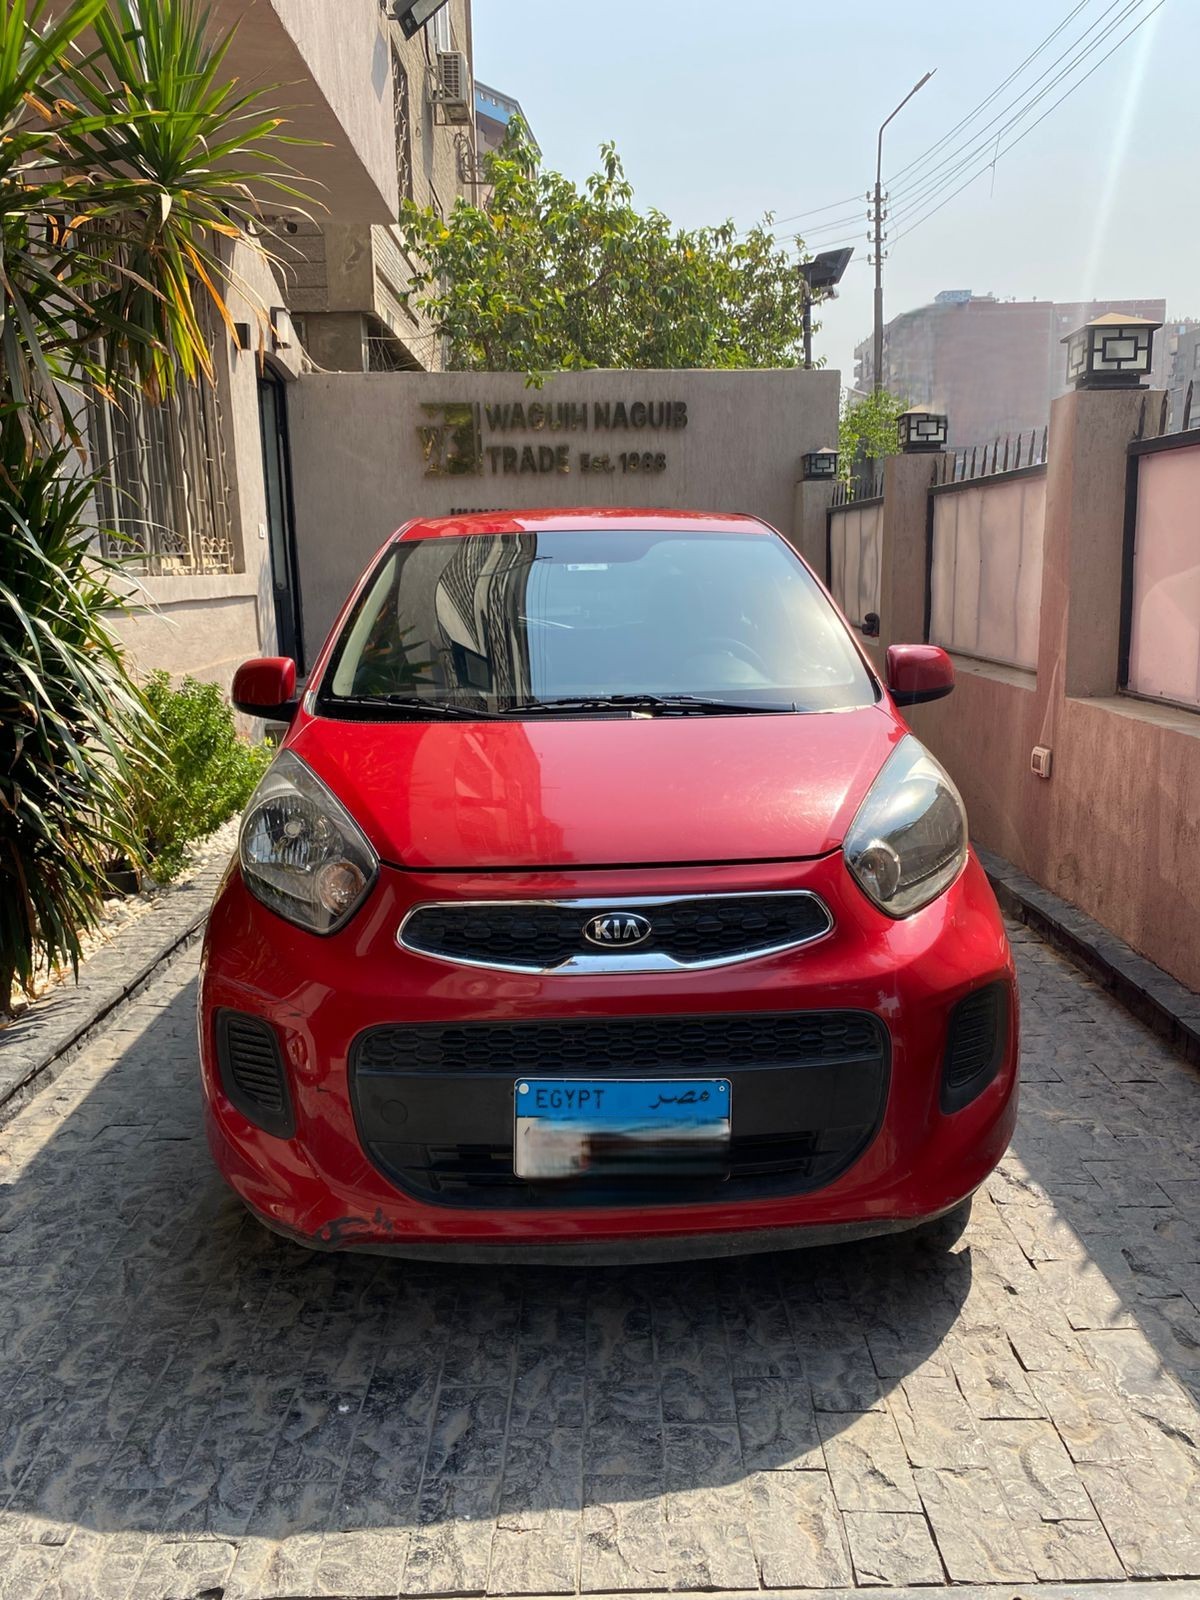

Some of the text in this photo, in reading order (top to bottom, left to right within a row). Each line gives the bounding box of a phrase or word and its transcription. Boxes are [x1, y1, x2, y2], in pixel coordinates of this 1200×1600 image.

[484, 402, 688, 432] WAGUIH NAGUIB
[485, 446, 570, 474] TRADE
[594, 919, 641, 939] KIA
[536, 1089, 605, 1109] EGYPT
[649, 1089, 710, 1109] مصر
